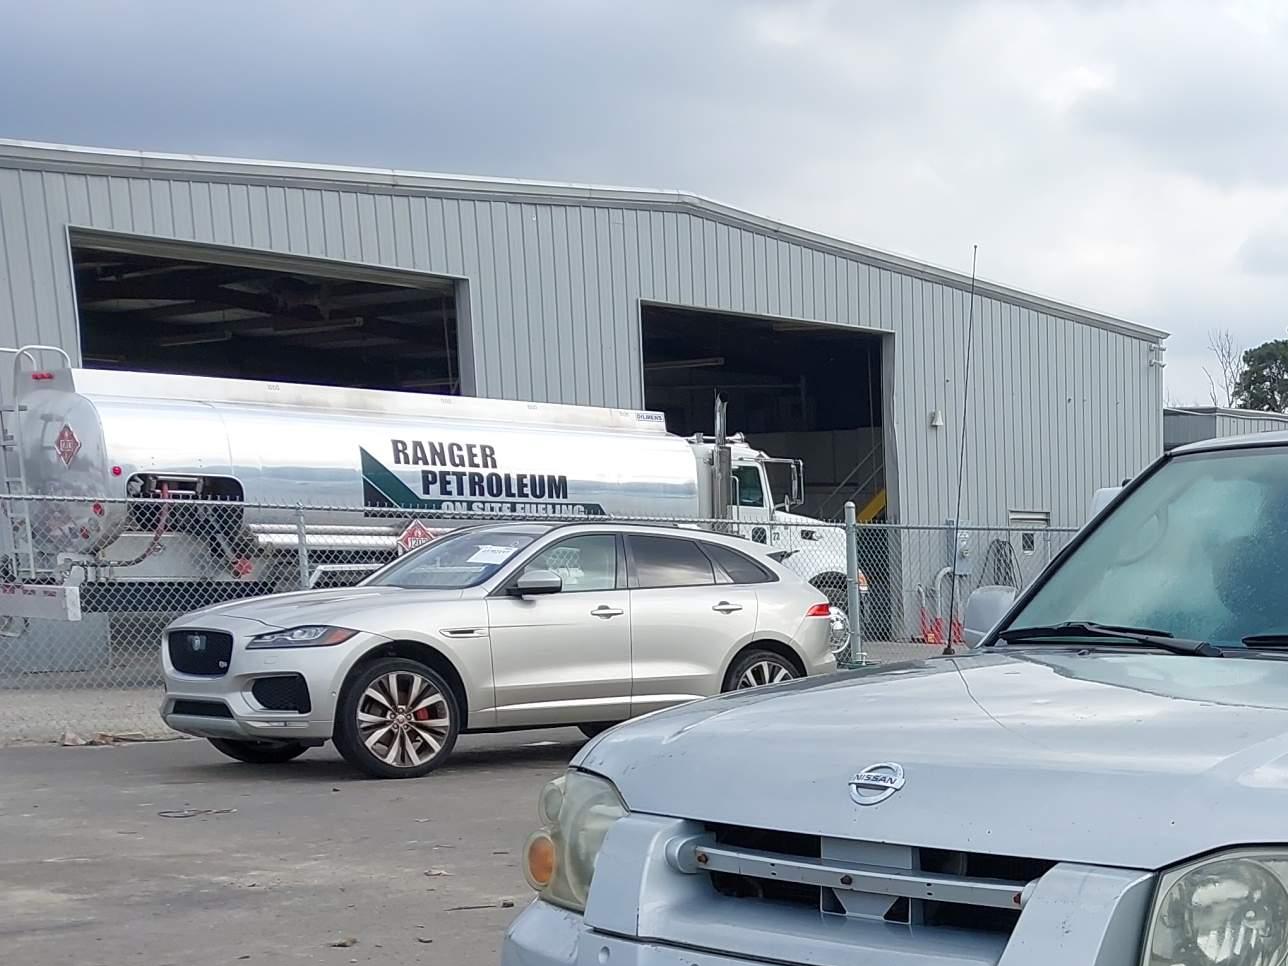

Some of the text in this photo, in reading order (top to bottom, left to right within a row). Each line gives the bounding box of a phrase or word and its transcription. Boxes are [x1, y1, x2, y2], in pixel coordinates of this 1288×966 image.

[391, 439, 497, 469] RANGER
[421, 469, 568, 500] PETROLEUM
[855, 774, 897, 785] NISSAN
